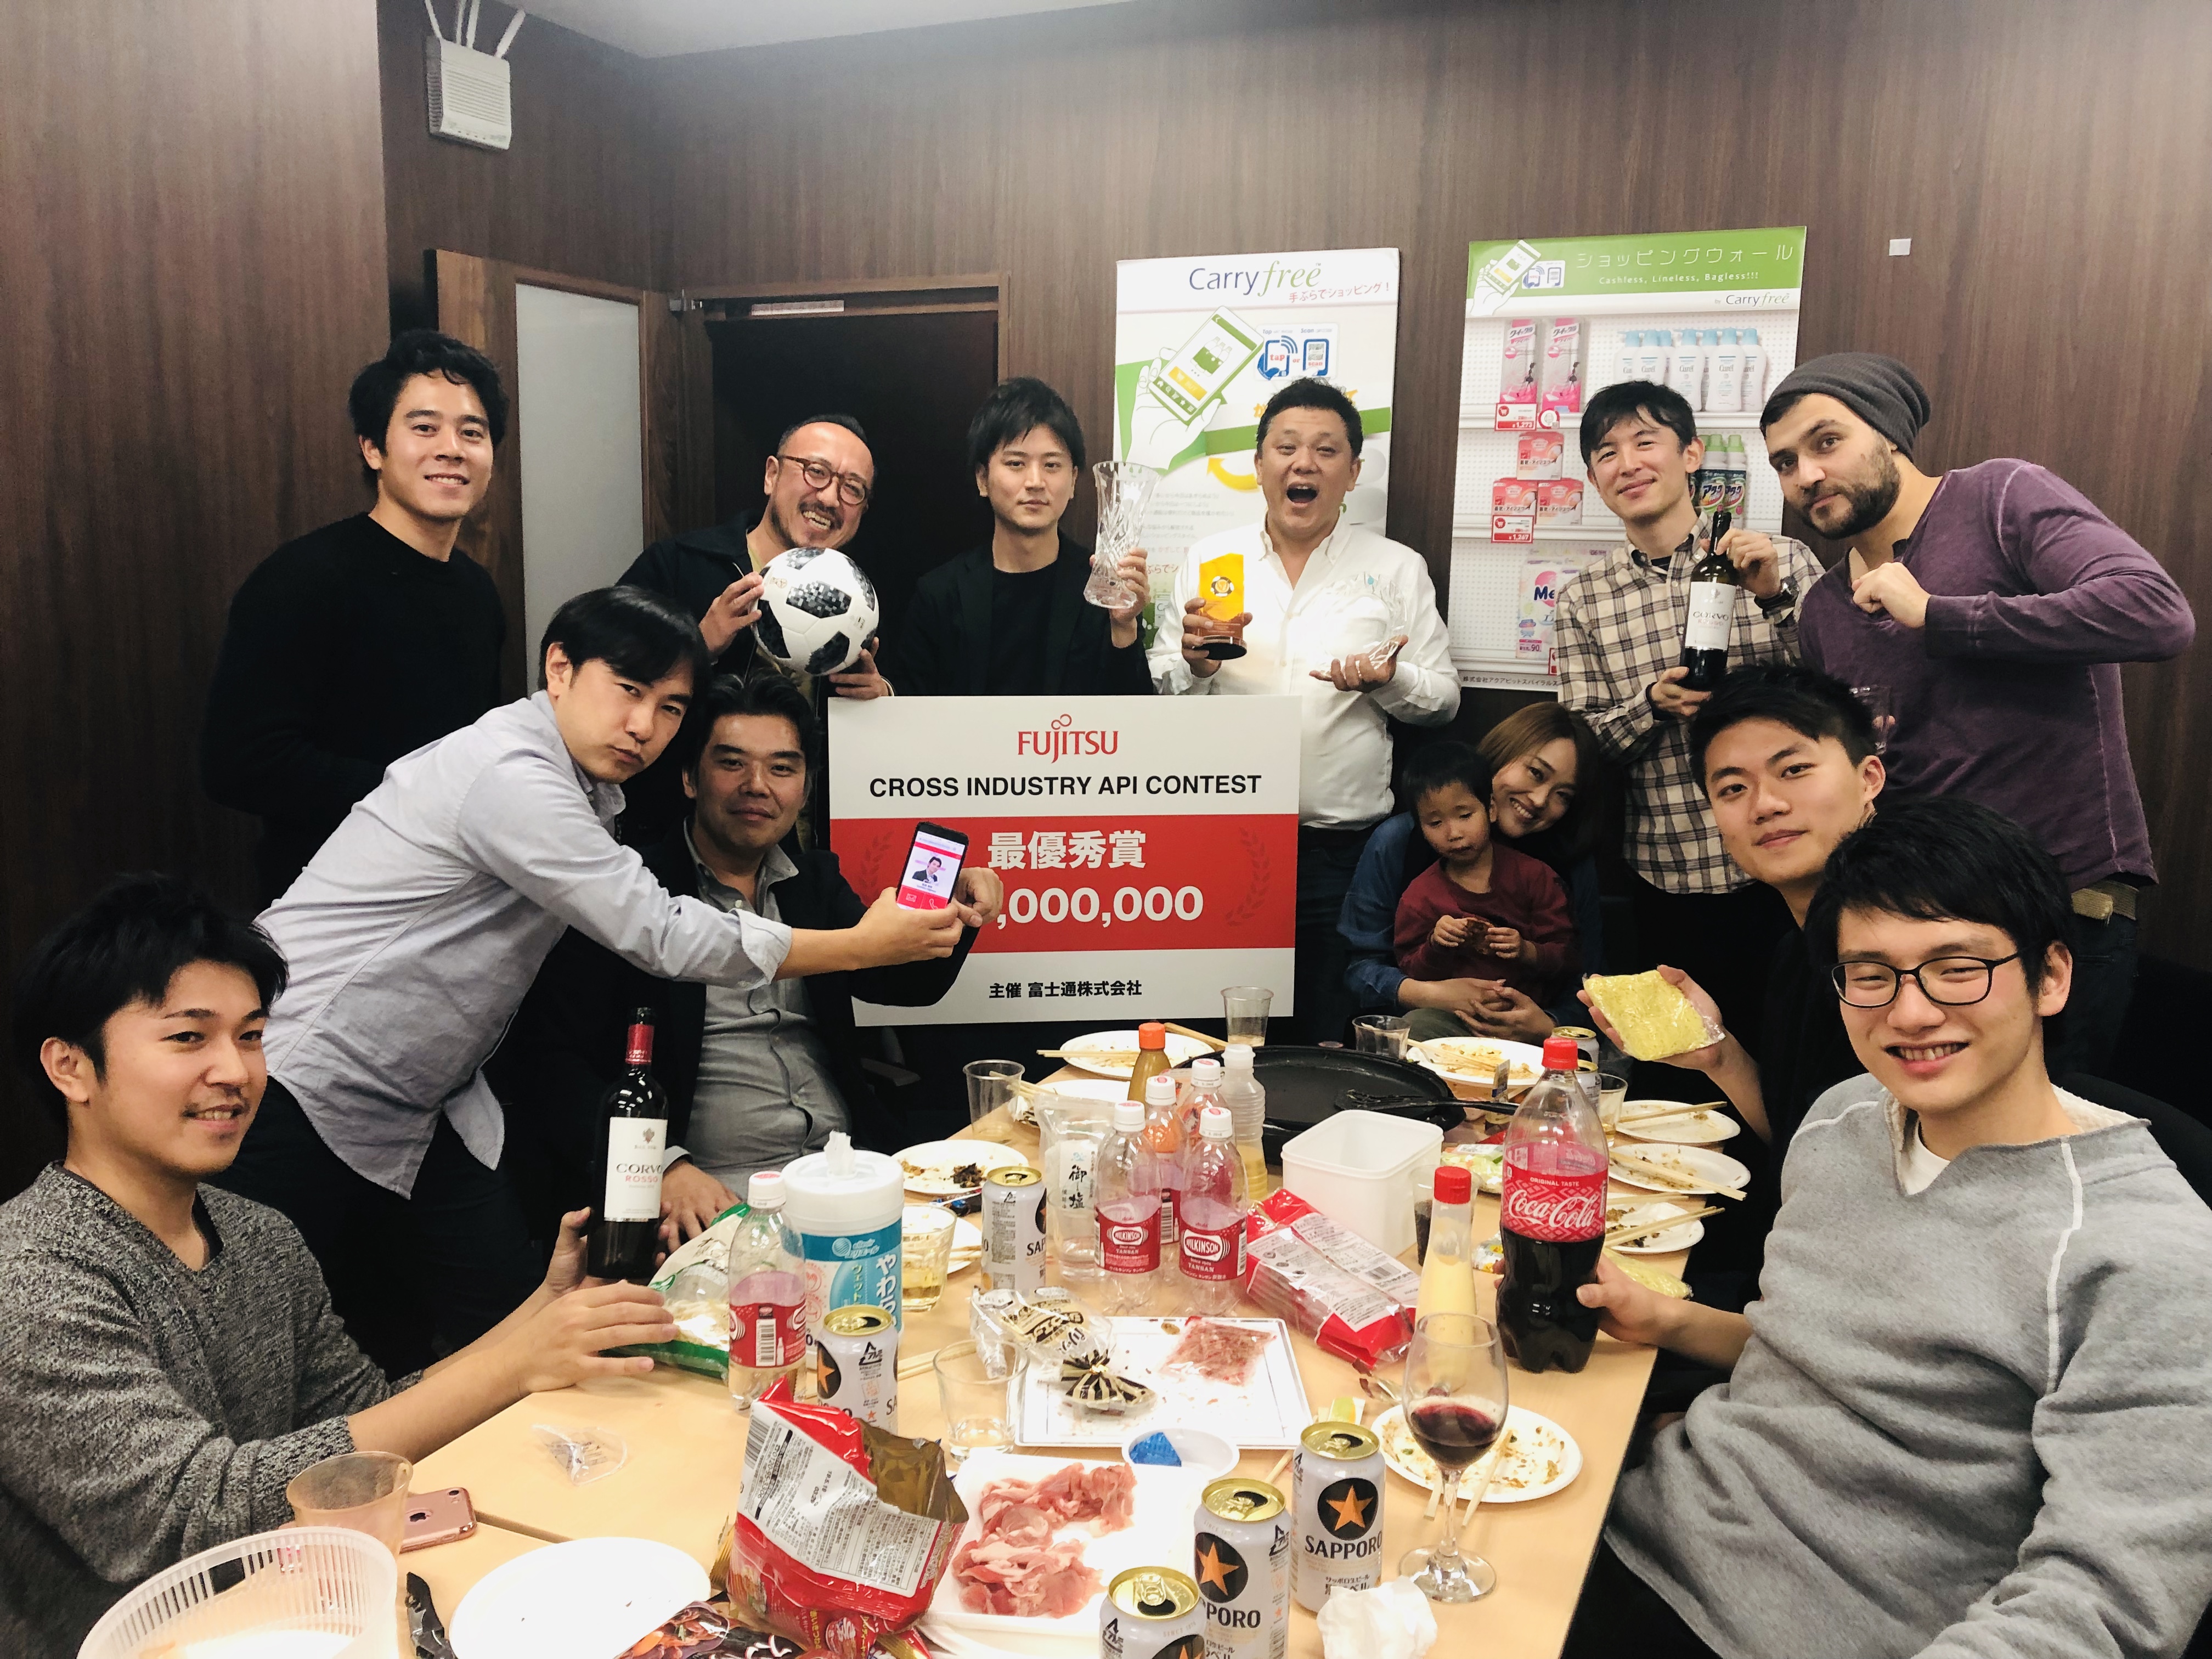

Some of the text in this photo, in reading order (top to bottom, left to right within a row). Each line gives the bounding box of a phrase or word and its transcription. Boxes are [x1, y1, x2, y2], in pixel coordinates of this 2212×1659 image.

[1576, 244, 1793, 268] ショッピングウォール
[1599, 271, 1759, 285] Cashless, Lineless, Bagless!!!
[1692, 610, 1729, 621] CORVO
[1018, 715, 1119, 763] FUJITSU
[870, 774, 1262, 797] CROSS INDUSTRY API CONTEST
[988, 830, 1147, 870] 最優秀賞
[997, 885, 1204, 929] ,000,000
[989, 979, 1143, 999] 主催 富士通株式会社
[616, 1163, 663, 1174] CORVO
[625, 1175, 658, 1183] ROSSO
[1530, 1176, 1560, 1187] ORIGINAL
[1508, 1189, 1599, 1228] Coca-Cola
[1115, 1231, 1141, 1241] WILKINSON
[1186, 1238, 1218, 1254] WILKINSON
[876, 1253, 897, 1327] やわら
[1305, 1531, 1383, 1560] SAPPORO
[1200, 1597, 1261, 1629] PORO
